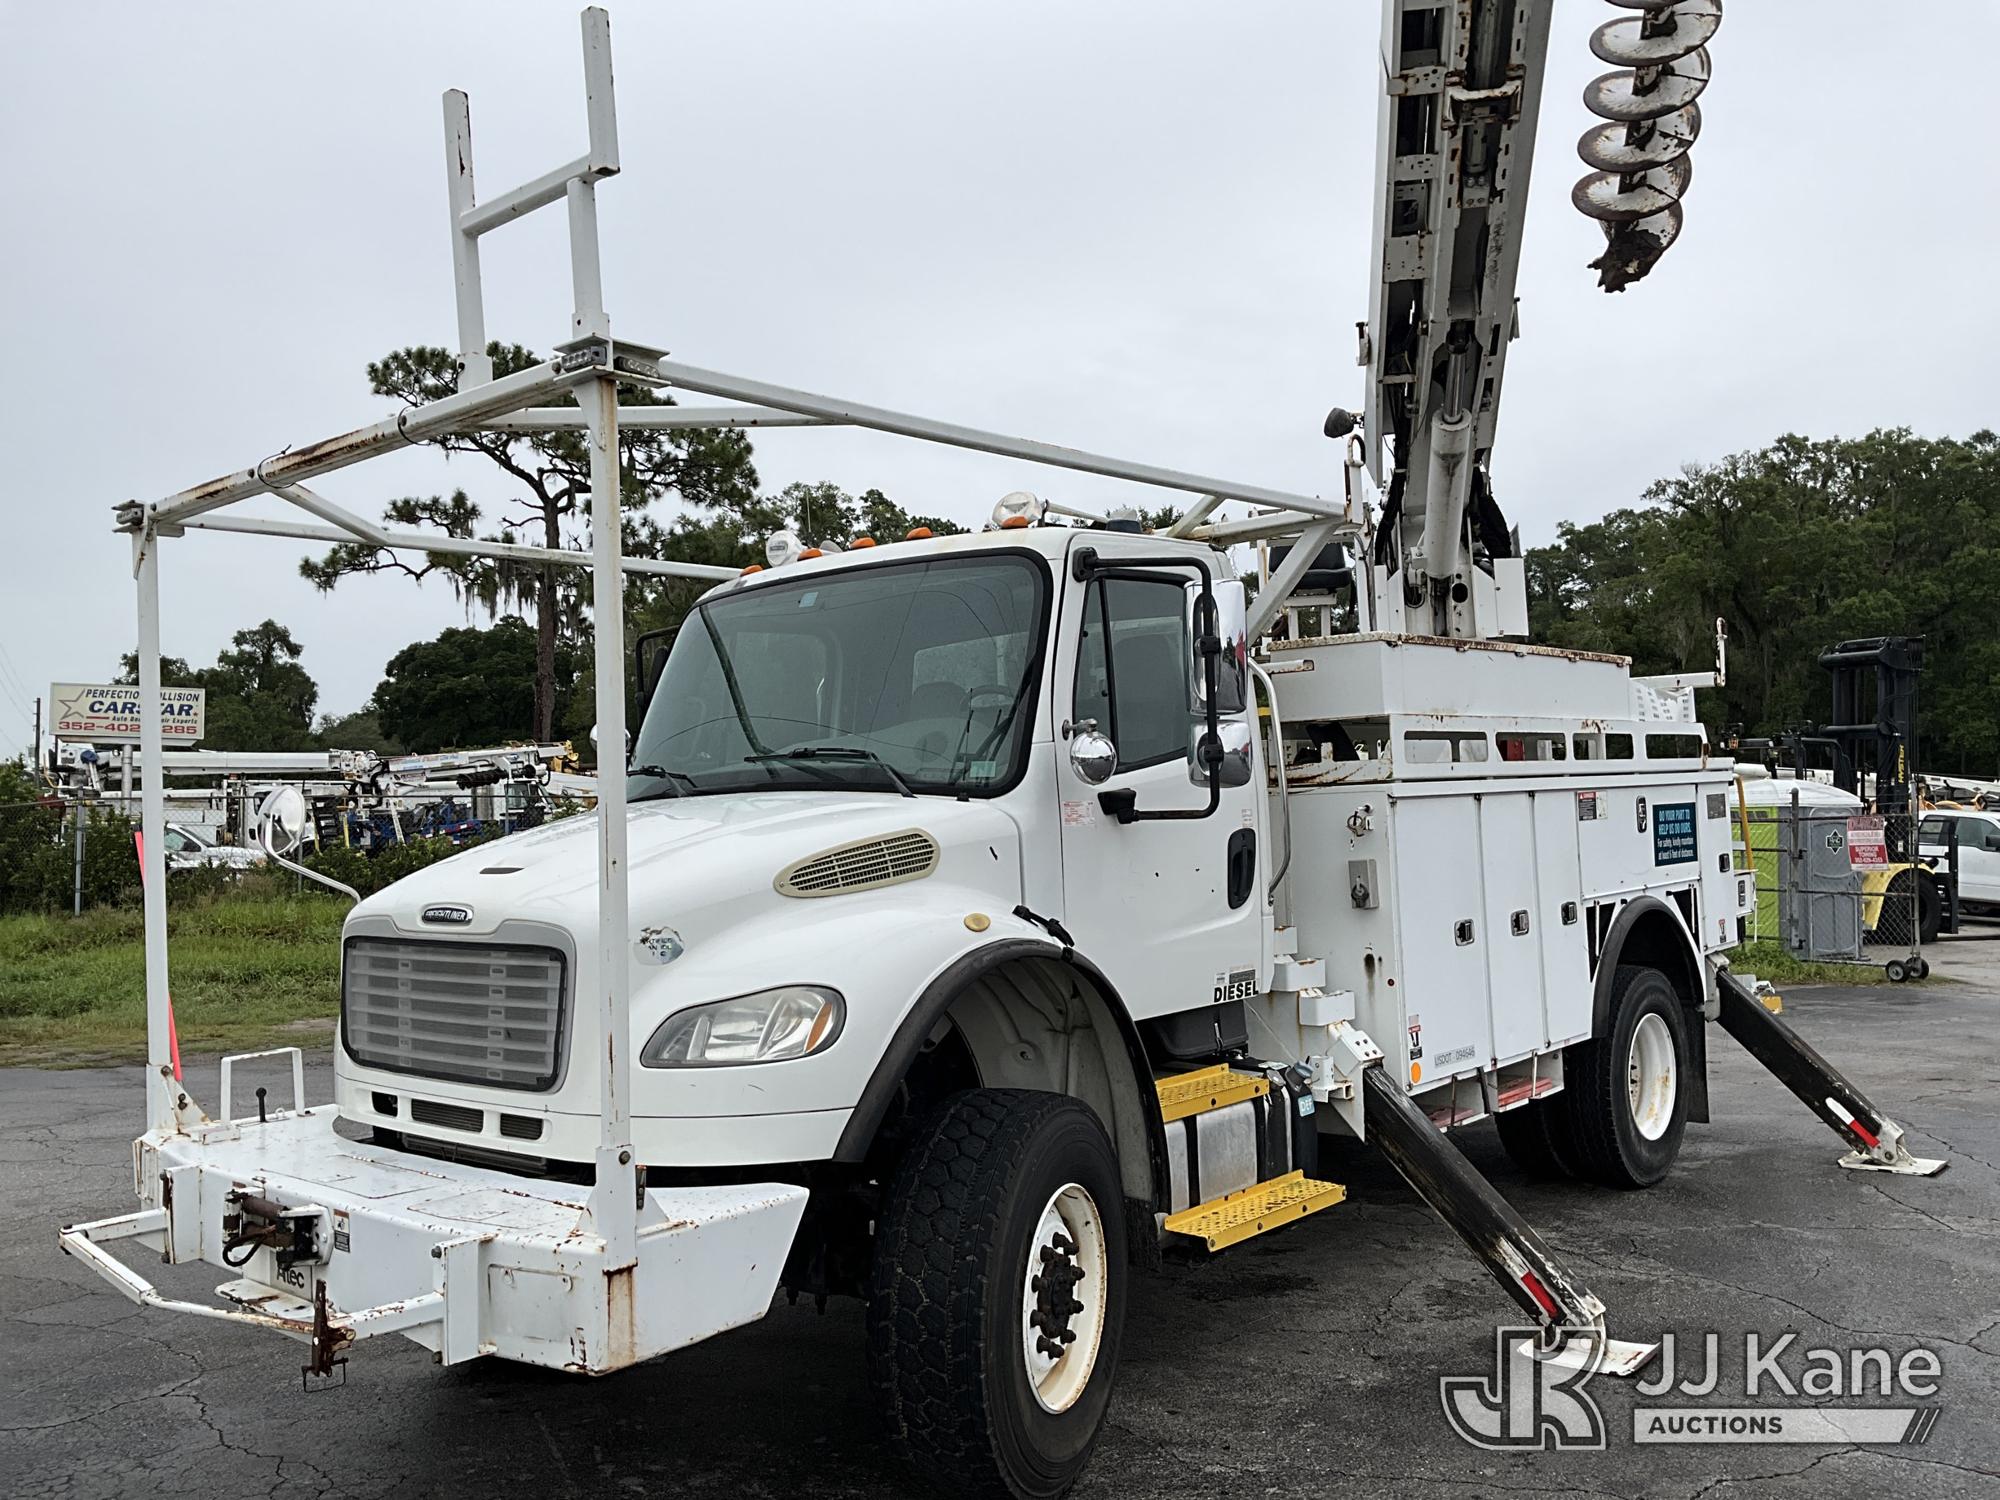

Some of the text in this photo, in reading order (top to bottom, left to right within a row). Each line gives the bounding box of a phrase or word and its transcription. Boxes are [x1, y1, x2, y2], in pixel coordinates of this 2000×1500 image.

[85, 688, 201, 702] PERFECTIO LLISION
[88, 700, 194, 717] CARAR
[58, 721, 198, 734] 352-402285
[1897, 744, 1905, 784] HYSTER
[1658, 823, 1669, 835] HELP
[1213, 980, 1259, 1003] DIESEL
